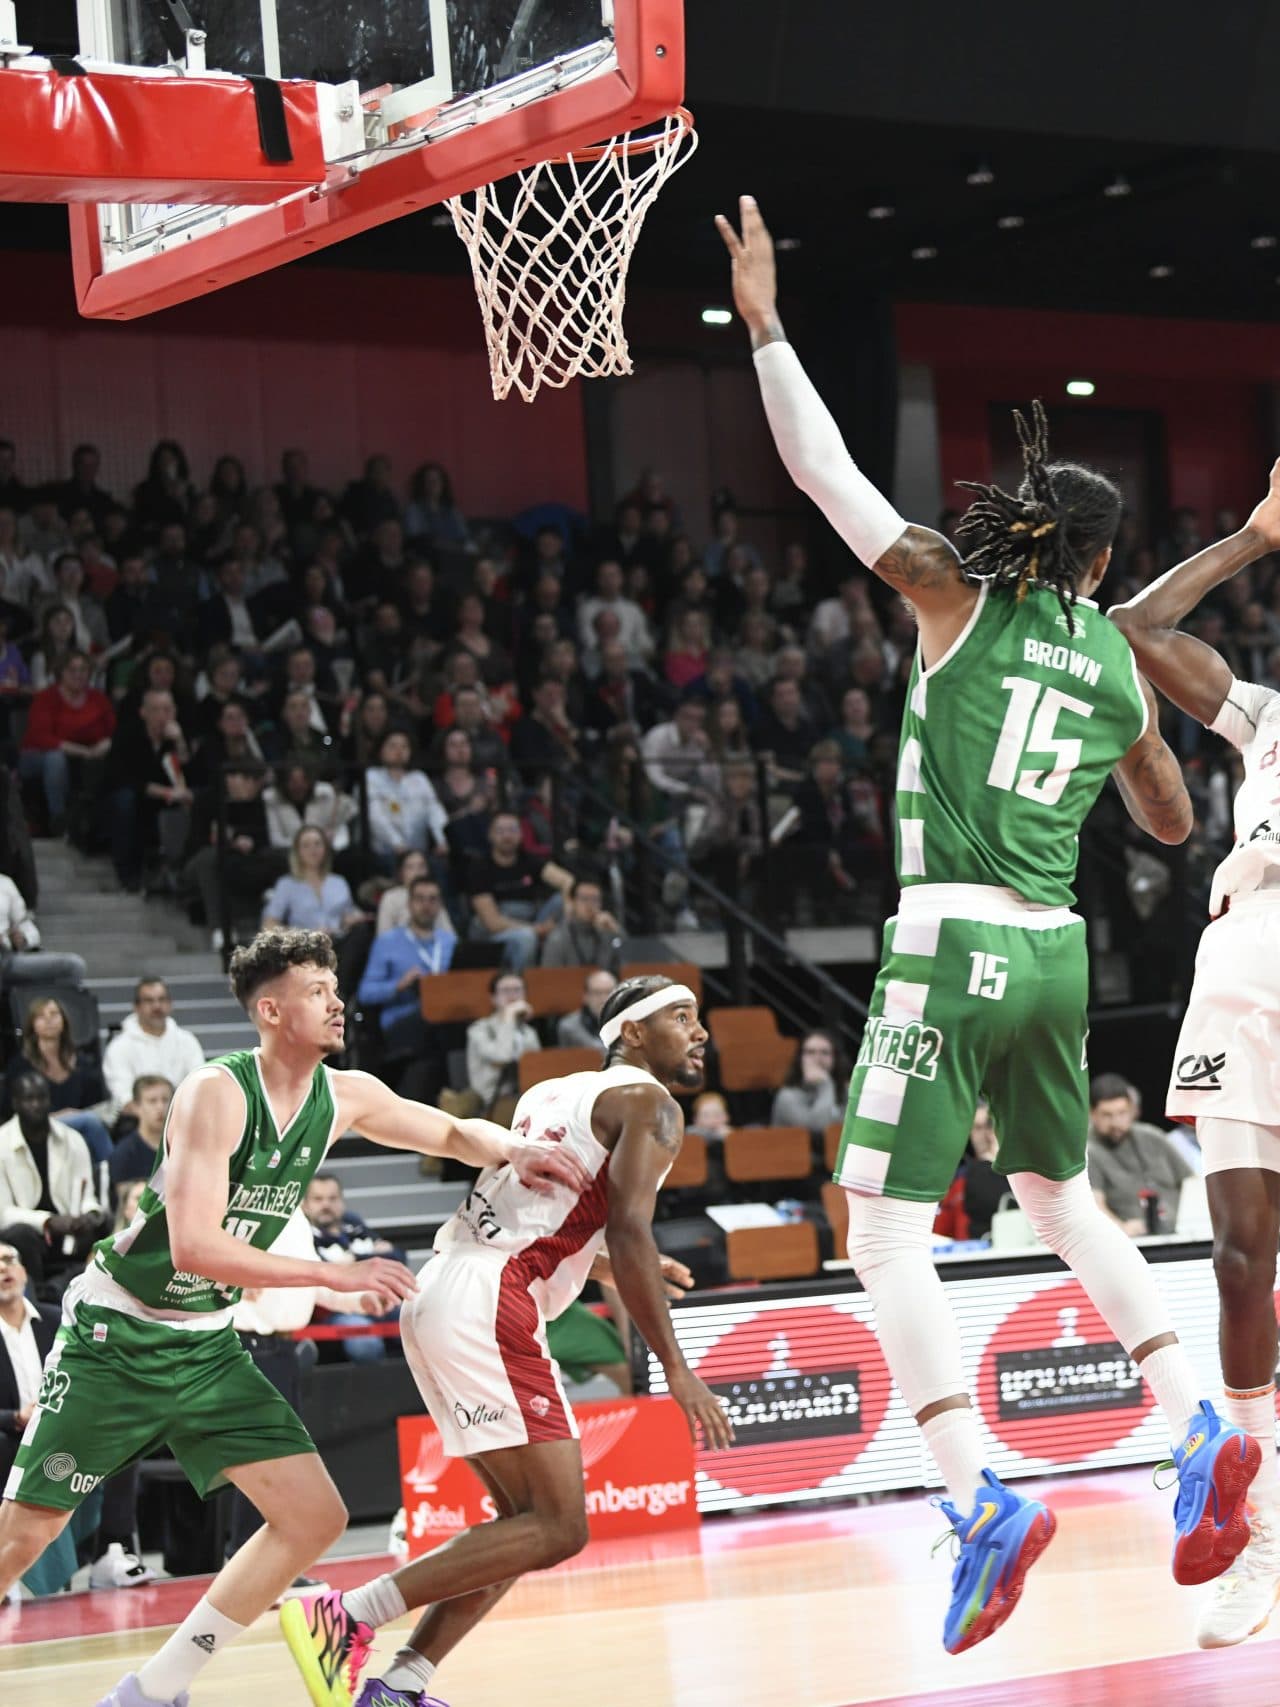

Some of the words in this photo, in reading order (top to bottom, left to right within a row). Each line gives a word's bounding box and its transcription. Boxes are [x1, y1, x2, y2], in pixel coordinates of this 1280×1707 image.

[1023, 637, 1103, 687] BROWN
[986, 675, 1095, 806] 15
[967, 950, 1009, 1001] 15
